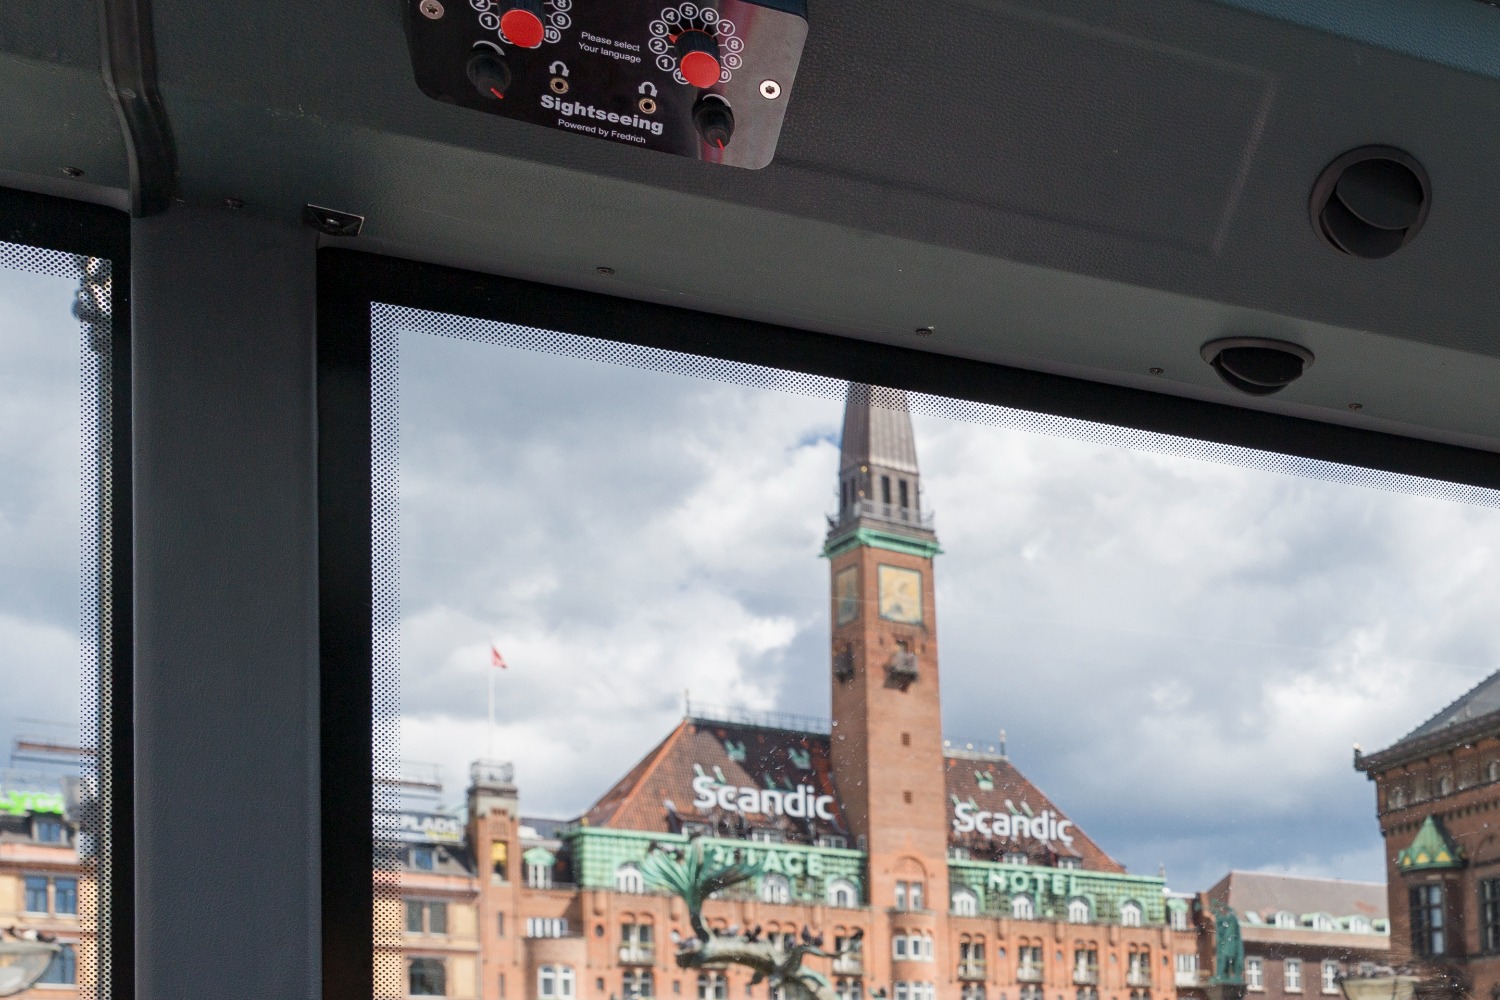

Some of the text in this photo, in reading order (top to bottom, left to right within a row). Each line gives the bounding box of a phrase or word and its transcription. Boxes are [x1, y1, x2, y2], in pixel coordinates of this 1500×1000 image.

[666, 11, 675, 21] 4
[685, 6, 693, 16] 5
[705, 11, 714, 21] 6
[484, 16, 492, 26] 1
[556, 16, 566, 26] 9
[655, 24, 664, 33] 3
[722, 23, 730, 33] 7
[581, 32, 640, 52] Please select
[654, 41, 662, 50] 2
[730, 40, 739, 50] 8
[578, 42, 642, 64] Your language
[661, 58, 669, 68] 1
[729, 56, 737, 66] 9
[540, 94, 664, 135] Sightseeing
[558, 118, 646, 144] Powered by Fredrich
[692, 774, 835, 820] Scandic
[954, 802, 1074, 843] Scandic
[988, 869, 1084, 896] HOTEL
